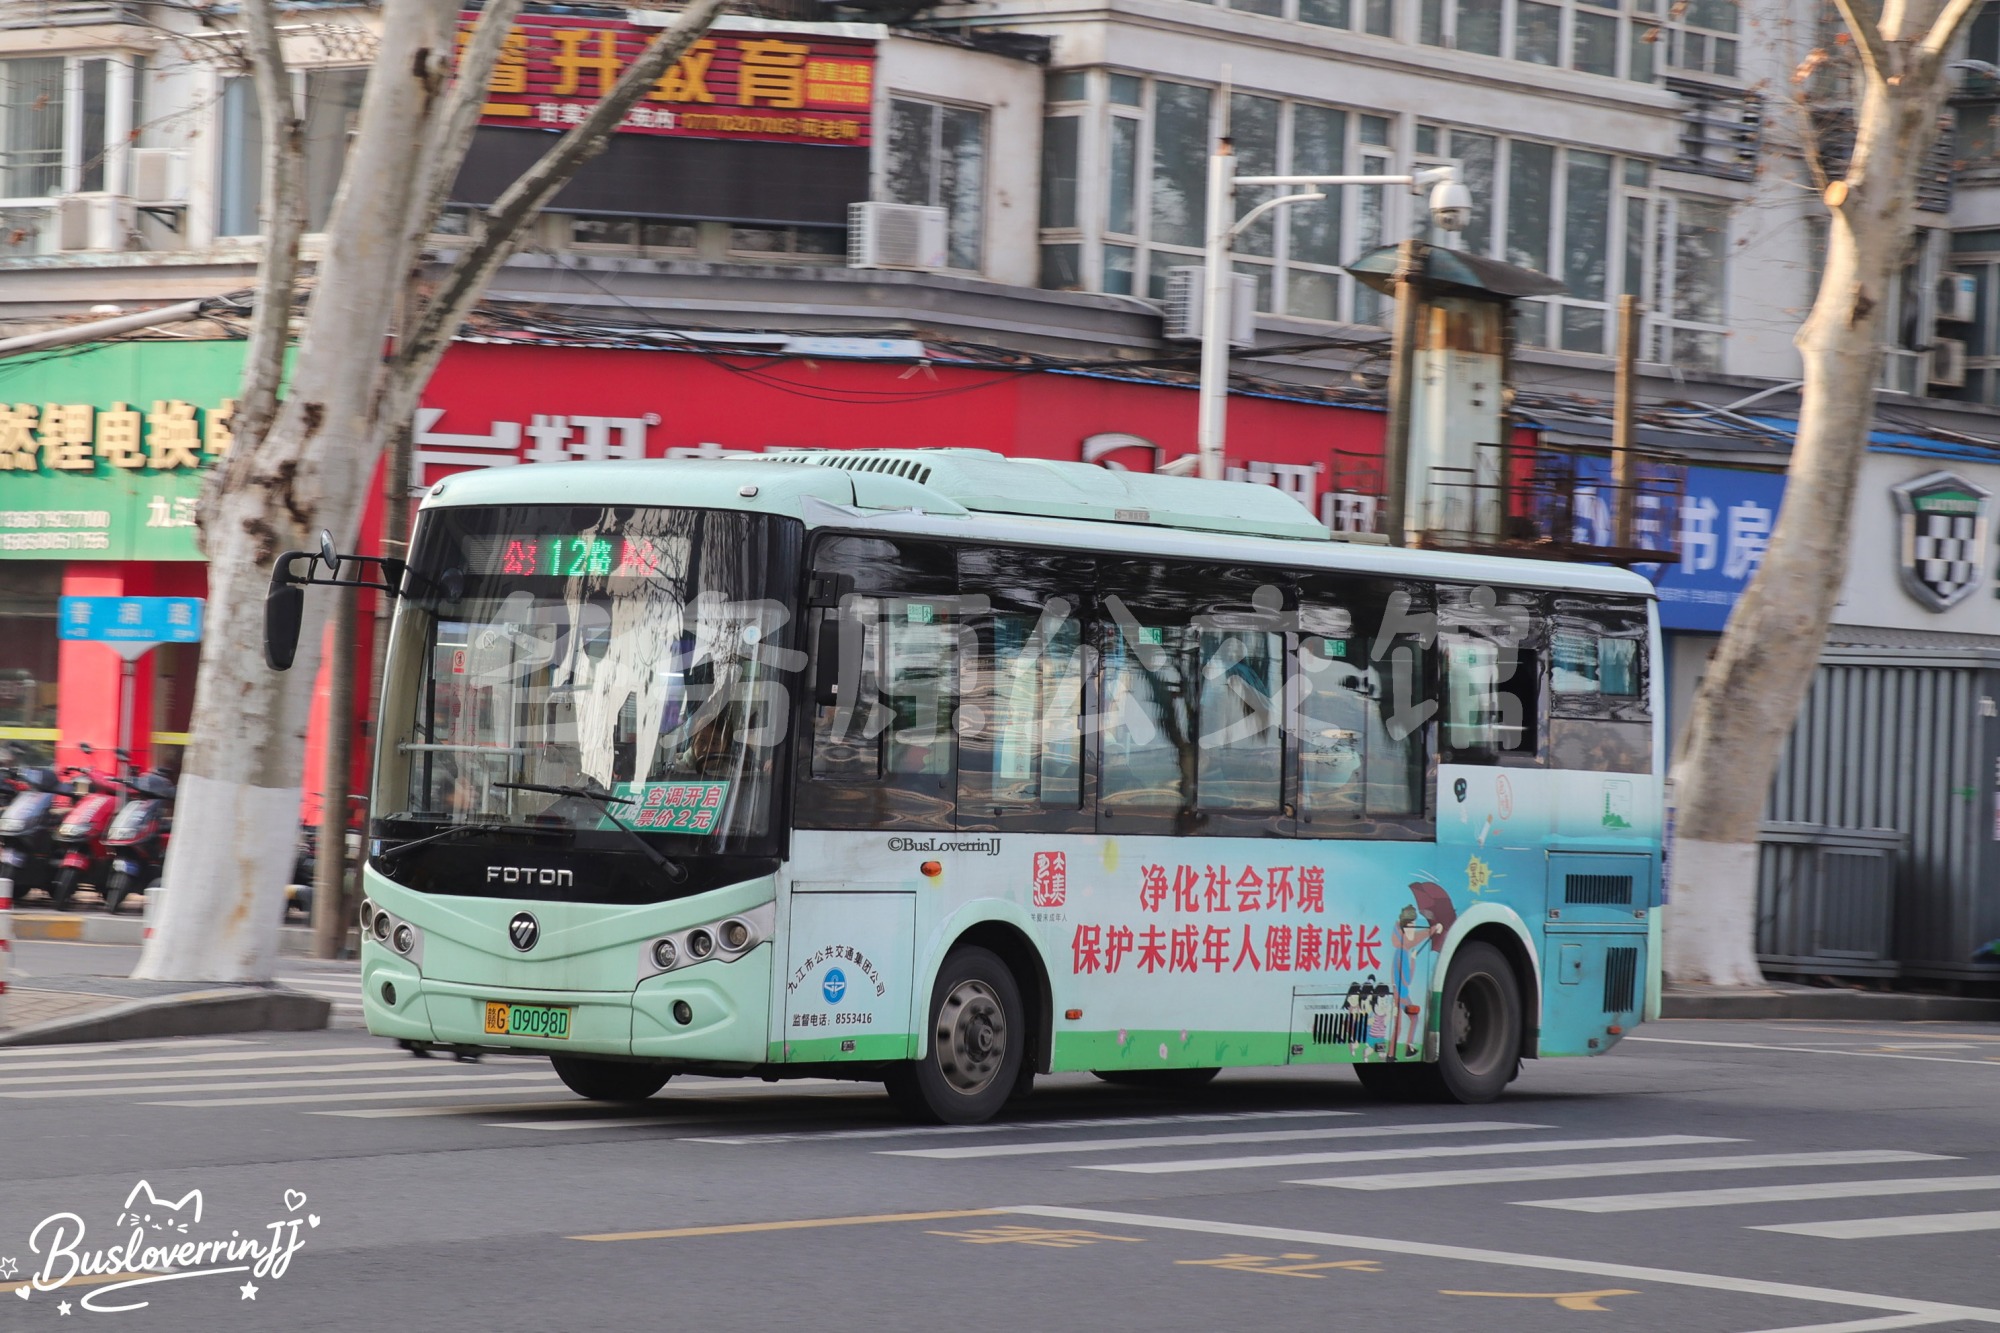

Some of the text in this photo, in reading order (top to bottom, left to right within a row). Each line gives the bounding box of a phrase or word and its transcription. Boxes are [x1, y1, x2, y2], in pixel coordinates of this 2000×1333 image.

[644, 786, 722, 807] 空调开启
[634, 808, 712, 830] 票价2元
[487, 866, 574, 887] FOTON
[1140, 864, 1325, 913] 净化社会环境
[1071, 923, 1382, 975] 保护未成年人健康成长
[787, 944, 886, 998] 九江市公共交通集团公司
